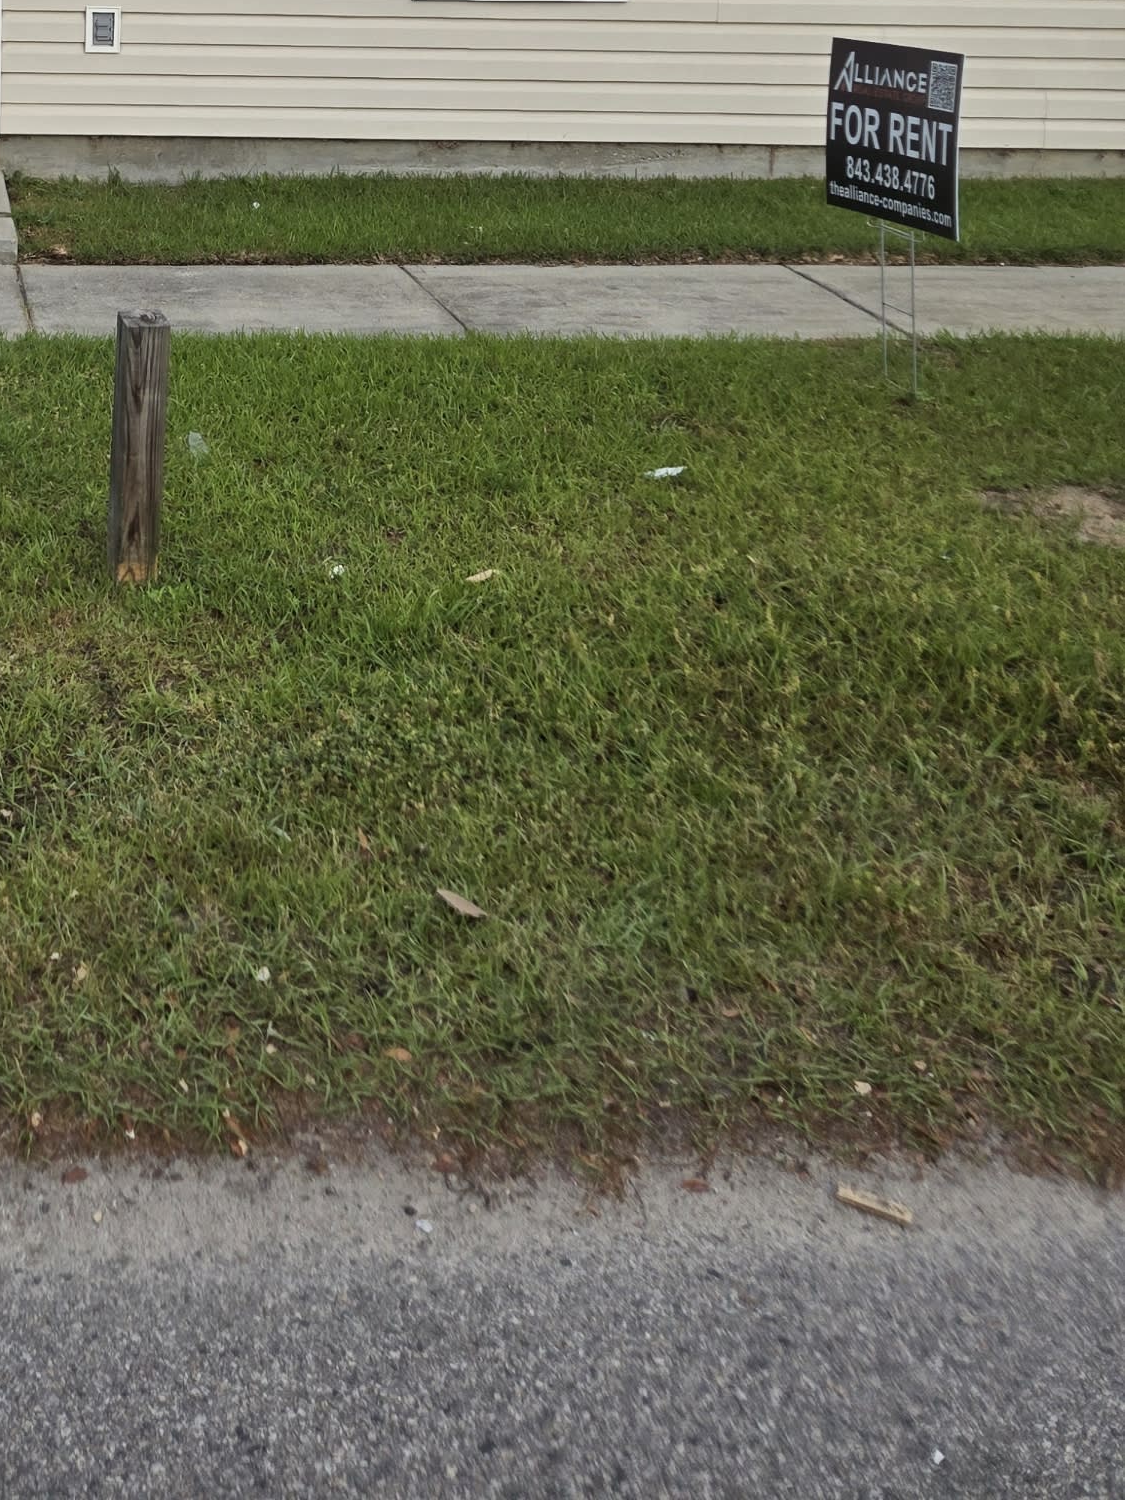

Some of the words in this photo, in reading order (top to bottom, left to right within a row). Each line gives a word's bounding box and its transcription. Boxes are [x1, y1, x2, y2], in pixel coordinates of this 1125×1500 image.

[834, 51, 928, 93] ALLIANCE
[830, 102, 880, 149] FOR
[889, 112, 953, 166] RENT
[846, 156, 935, 200] 843.438.4776
[829, 181, 952, 227] thealliance-companies.com
